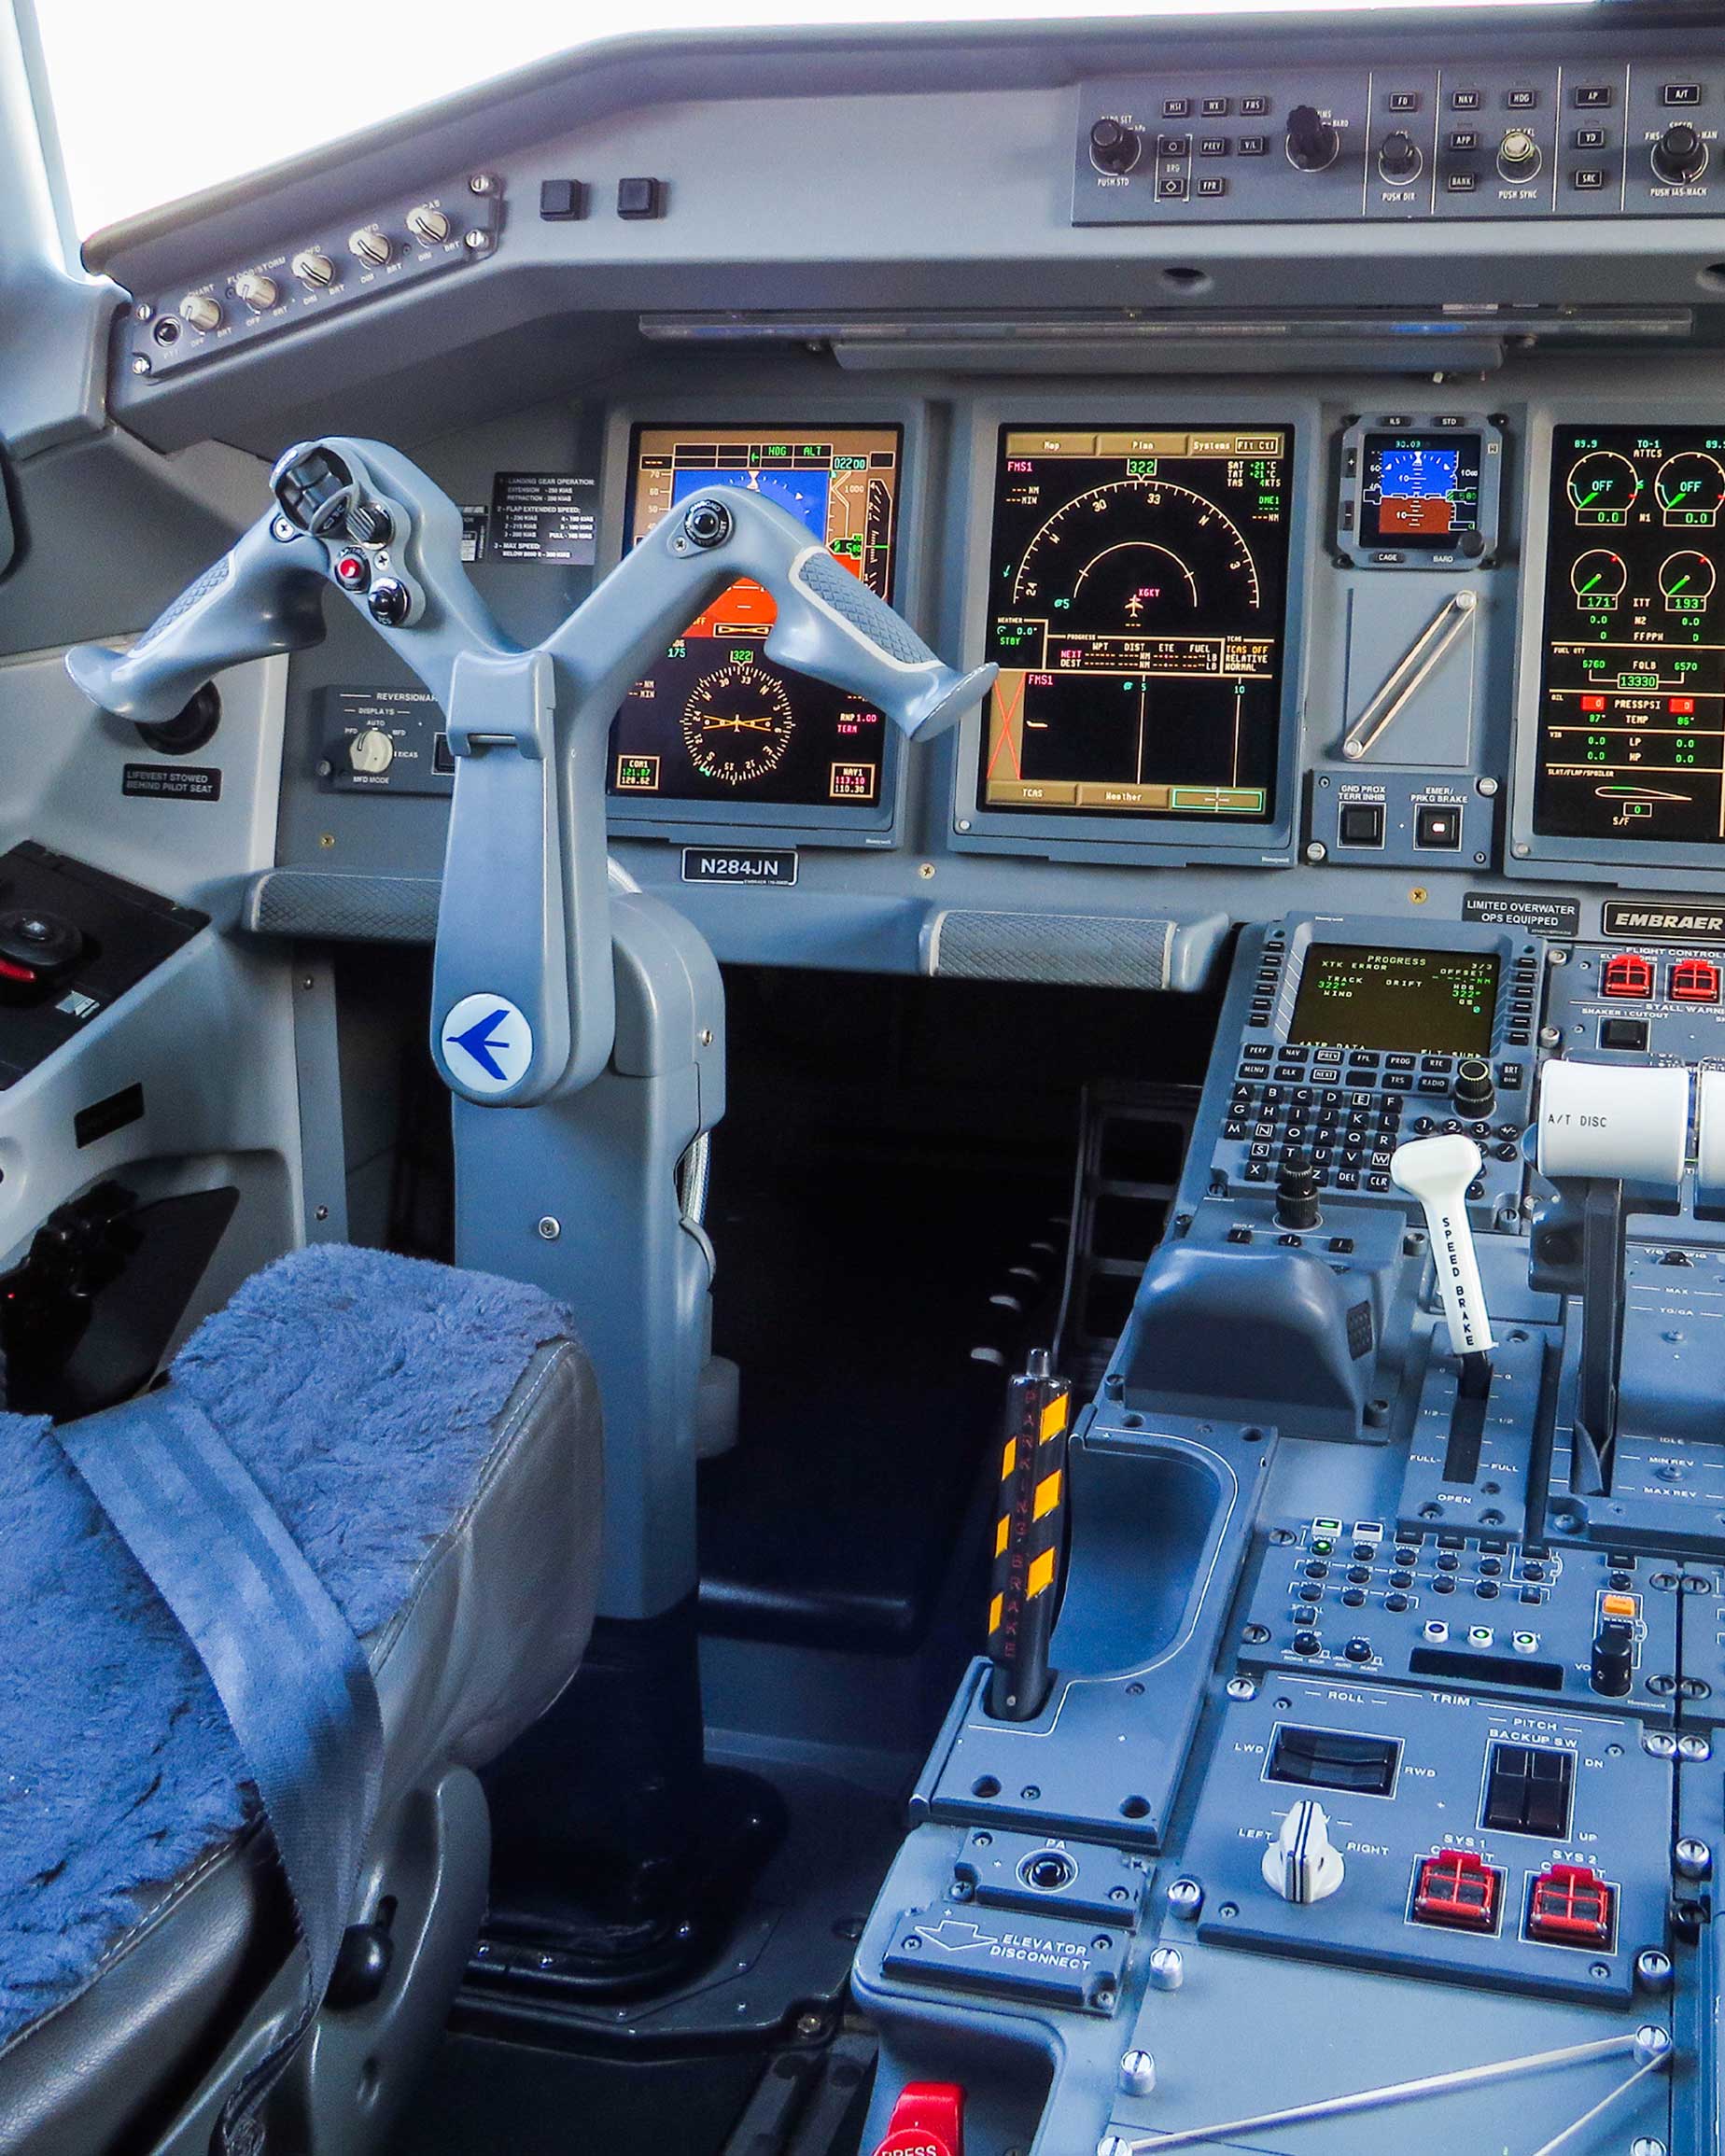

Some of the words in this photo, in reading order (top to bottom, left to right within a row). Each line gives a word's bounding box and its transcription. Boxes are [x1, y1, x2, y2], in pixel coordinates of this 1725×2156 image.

[1676, 89, 1689, 99] A/T
[1458, 95, 1473, 105] NAV
[1514, 94, 1530, 104] HDG
[1457, 136, 1471, 145] APP
[1203, 142, 1221, 151] PREV
[1498, 190, 1518, 200] PUSH
[1520, 189, 1537, 199] SYNC
[1650, 188, 1670, 197] PUSH
[1044, 441, 1060, 451] Map
[1132, 441, 1153, 450] Plan
[1193, 441, 1230, 451] Systems
[1238, 441, 1254, 450] Flt
[1575, 440, 1597, 448] 89.9
[1637, 440, 1660, 448] TO-1
[768, 446, 786, 456] HDG
[803, 446, 821, 456] ALT
[1634, 449, 1662, 458] ATTCS
[834, 457, 865, 469] 02200
[1007, 462, 1032, 472] FMS1
[1129, 461, 1155, 473] 322
[1227, 461, 1243, 469] SAT
[1227, 470, 1243, 479] TAT
[1227, 479, 1243, 487] TAS
[1592, 481, 1613, 491] OFF
[1680, 482, 1702, 492] OFF
[845, 485, 864, 494] 1000
[1259, 496, 1279, 505] DME1
[1598, 512, 1619, 522] 0.0
[1634, 598, 1650, 607] ITT
[1000, 637, 1020, 646] STBY
[1634, 633, 1664, 641] FFPPH
[1124, 643, 1145, 651] DIST
[1189, 644, 1211, 652] FUEL
[1227, 646, 1249, 654] TCAS
[1252, 646, 1268, 654] OFF
[667, 648, 686, 658] 175
[734, 651, 751, 660] 322
[1060, 659, 1081, 667] DEST
[1226, 654, 1268, 663] RELATIVE
[1583, 660, 1605, 668] 6760
[1675, 663, 1697, 671] 6570
[1029, 675, 1053, 685] FMS1
[1620, 677, 1656, 687] 13330
[1234, 685, 1245, 694] 10
[857, 714, 877, 722] 1.00
[1626, 715, 1649, 724] TEMP
[837, 724, 857, 733] TERM
[1630, 737, 1642, 746] LP
[1629, 753, 1641, 762] HP
[127, 771, 167, 779] LIFEVEST
[170, 774, 207, 783] STOWED
[127, 780, 161, 790] BEHIND
[190, 785, 212, 793] SEAT
[834, 785, 864, 793] 110.30
[1023, 789, 1043, 798] TCAS
[1106, 792, 1142, 802] Weather
[1613, 818, 1630, 826] S/F
[700, 859, 778, 875] N284JN
[1467, 901, 1508, 911] LIMITED
[1510, 903, 1575, 915] OVERWATER
[1482, 913, 1503, 923] OPS
[1506, 915, 1558, 926] EQUIPPED
[1616, 913, 1724, 930] EMBRAER
[1626, 946, 1665, 955] FLIGHT
[1367, 956, 1426, 965] PROGRESS
[1647, 1003, 1683, 1012] STALL
[1629, 1011, 1669, 1019] CUTOUT
[1391, 1057, 1410, 1066] PROG
[1244, 1065, 1265, 1074] MENU
[1504, 1066, 1519, 1075] BRT
[1422, 1079, 1445, 1087] RADIO
[1239, 1087, 1248, 1097] A
[1269, 1088, 1277, 1098] B
[1297, 1090, 1307, 1099] C
[1327, 1093, 1336, 1102] D
[1234, 1105, 1244, 1114] G
[1264, 1107, 1273, 1116] H
[1548, 1114, 1571, 1126] A/T
[1580, 1115, 1607, 1127] DISC
[1339, 1173, 1356, 1182] DEL
[1370, 1177, 1387, 1187] CLR
[1442, 1218, 1460, 1277] SPEED
[1456, 1286, 1474, 1346] BRAKE
[1409, 1455, 1437, 1463] FULL
[1673, 1458, 1695, 1467] REV
[1492, 1463, 1519, 1472] FULL
[1644, 1487, 1671, 1496] MAX
[1673, 1490, 1696, 1498] REV
[1438, 1494, 1472, 1504] OPEN
[1328, 1691, 1365, 1702] ROLL
[1431, 1693, 1471, 1705] TRIM
[1513, 1718, 1557, 1731] PITCH
[1490, 1729, 1550, 1743] BACKUP
[1554, 1738, 1577, 1747] SW
[1234, 1743, 1264, 1753] LWD
[1585, 1758, 1603, 1768] DN
[1405, 1767, 1437, 1777] RWD
[1239, 1828, 1273, 1840] LEFT
[1579, 1833, 1597, 1841] UP
[1046, 1839, 1065, 1849] PA
[1443, 1835, 1473, 1847] SYS
[1347, 1842, 1389, 1855] RIGHT
[1002, 1934, 1087, 1956] ELEVATOR
[989, 1946, 1090, 1971] DISCONNECT
